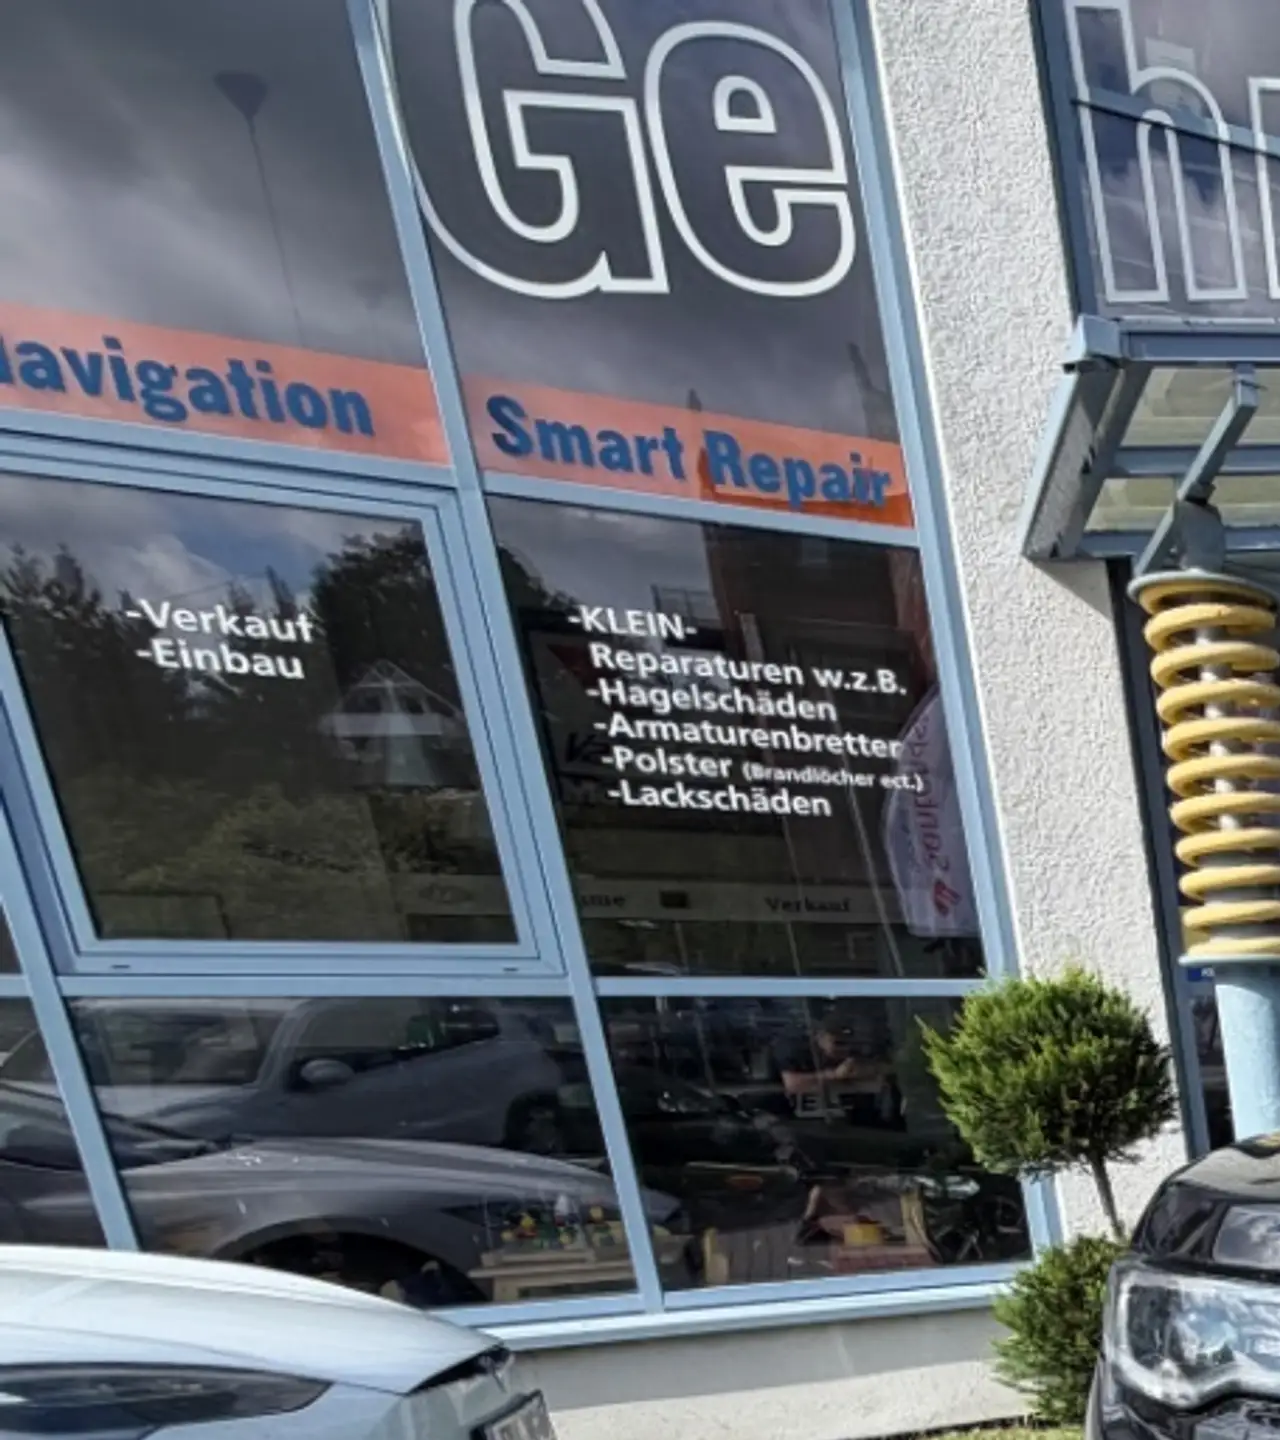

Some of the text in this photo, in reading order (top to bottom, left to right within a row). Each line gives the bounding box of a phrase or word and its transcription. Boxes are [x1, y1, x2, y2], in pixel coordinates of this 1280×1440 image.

[370, 0, 857, 299] Ge
[486, 394, 892, 508] Smart Repair
[567, 604, 698, 641] -KLEIN-
[136, 637, 305, 679] -Einbau
[589, 642, 907, 695] Reparaturen w.z.B.
[586, 677, 838, 722] -Hagelschäden
[593, 713, 904, 760] -Armaturenbretter
[601, 745, 732, 777] -Polster
[607, 778, 832, 817] -Lackschäden
